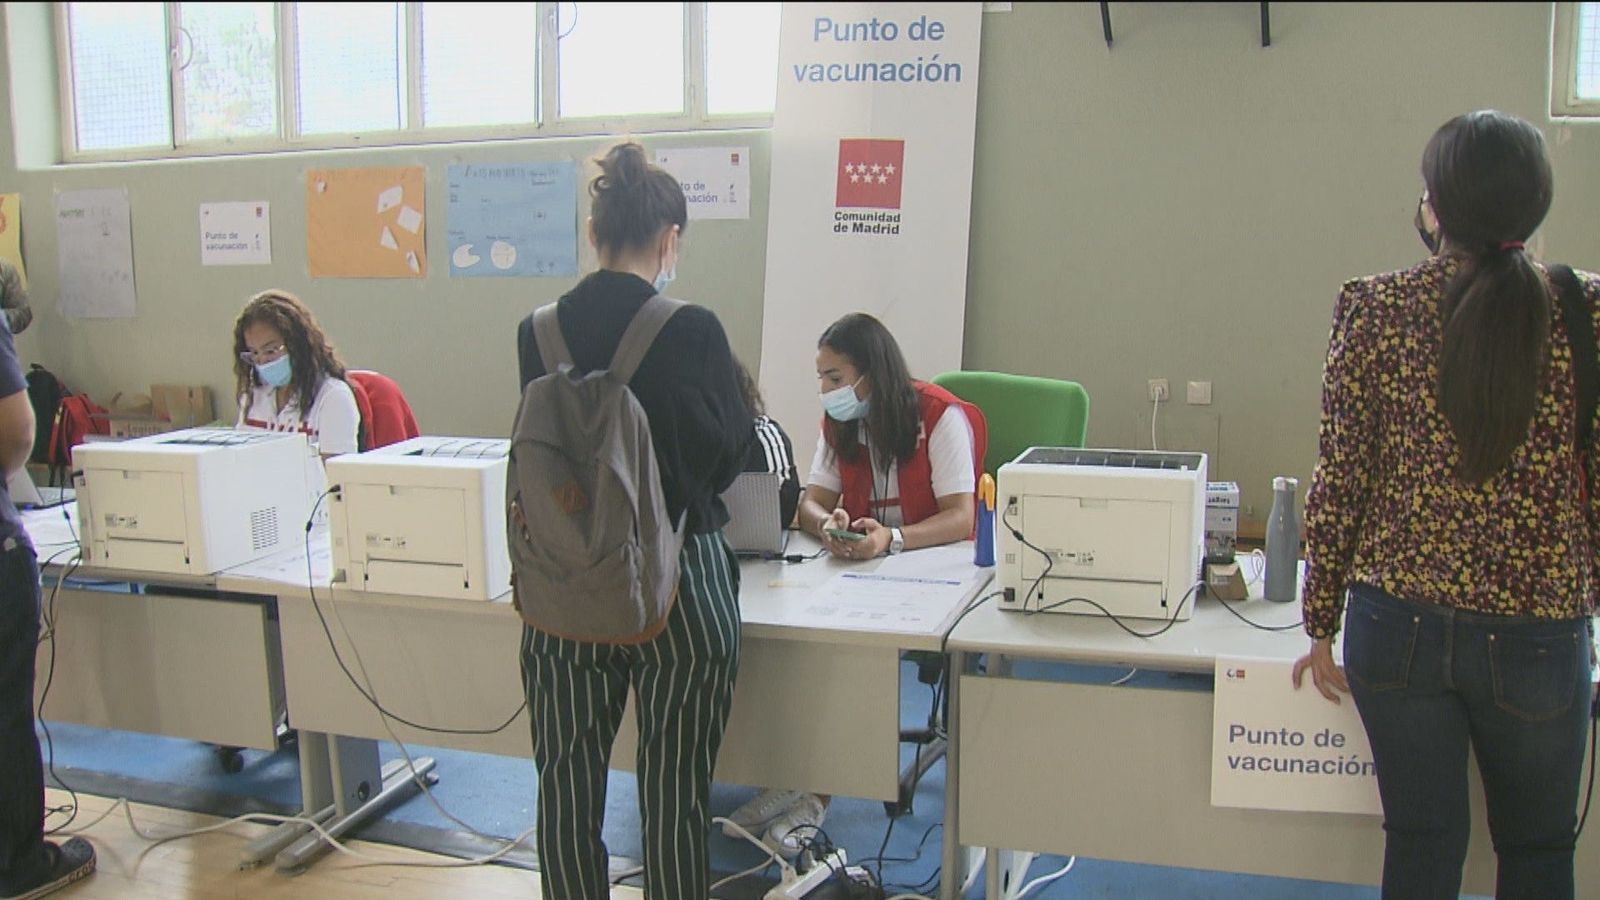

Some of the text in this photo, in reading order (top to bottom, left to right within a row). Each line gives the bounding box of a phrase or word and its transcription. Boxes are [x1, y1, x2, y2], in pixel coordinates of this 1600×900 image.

[813, 15, 945, 42] Punto de
[793, 54, 962, 83] vacunación
[686, 192, 718, 203] nación
[834, 211, 901, 223] Comunidad
[833, 222, 900, 235] de Madrid
[1229, 724, 1346, 748] Punto de
[1227, 754, 1376, 776] vacunación
